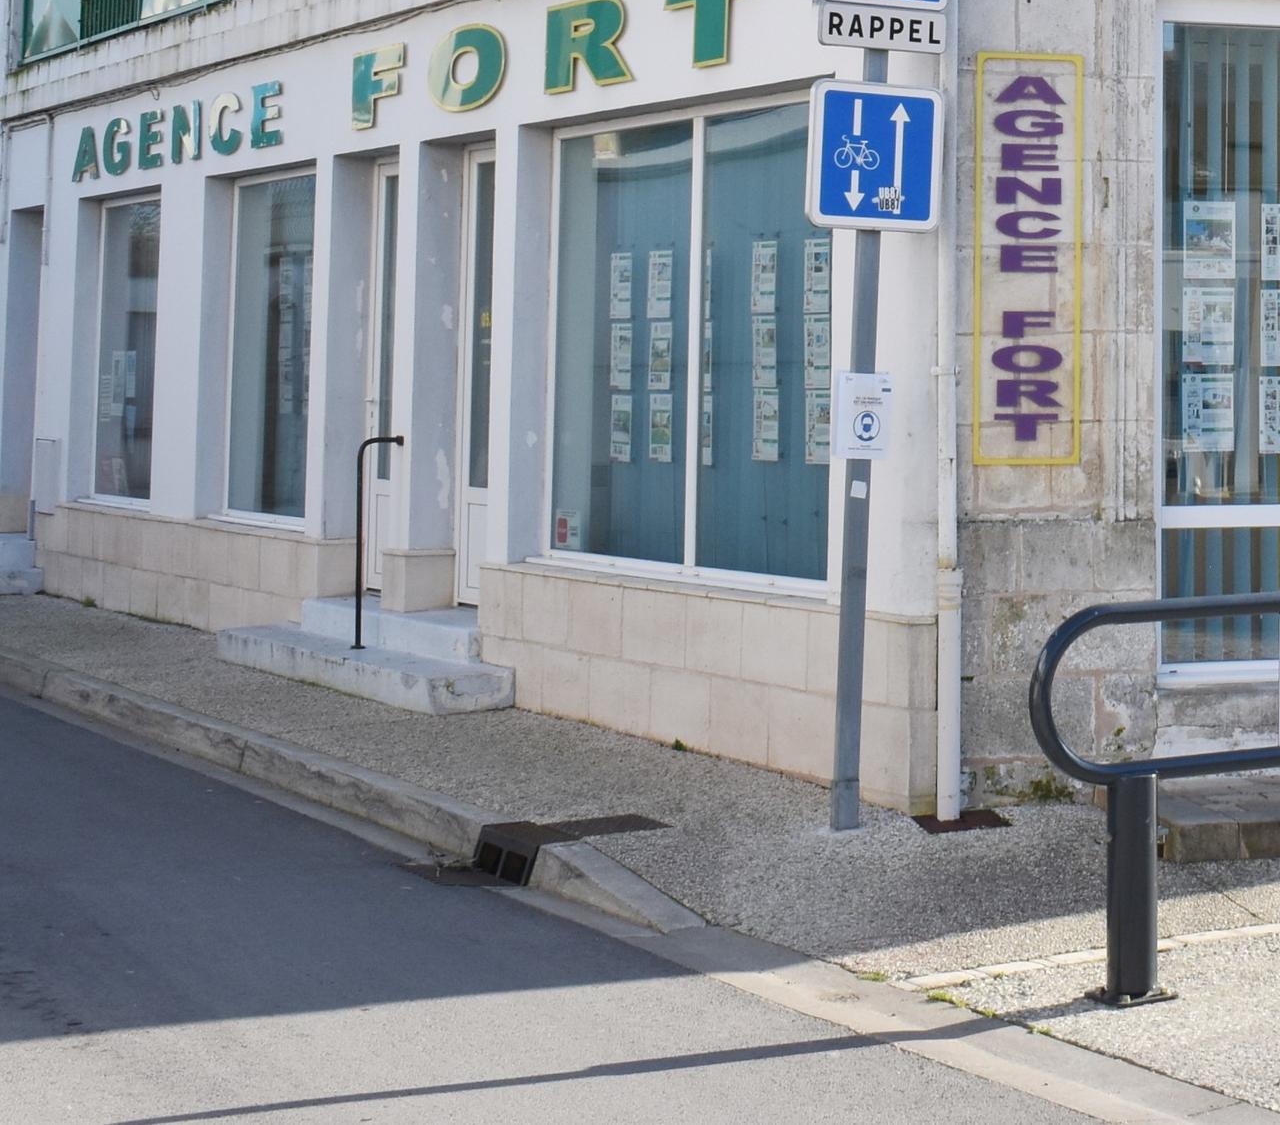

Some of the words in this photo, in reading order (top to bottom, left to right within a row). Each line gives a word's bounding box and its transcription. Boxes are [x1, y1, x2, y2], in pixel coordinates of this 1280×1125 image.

[827, 11, 942, 46] RAPPEL
[71, 80, 284, 183] AGENCE
[993, 75, 1067, 274] AGENCE
[991, 310, 1064, 443] FORT
